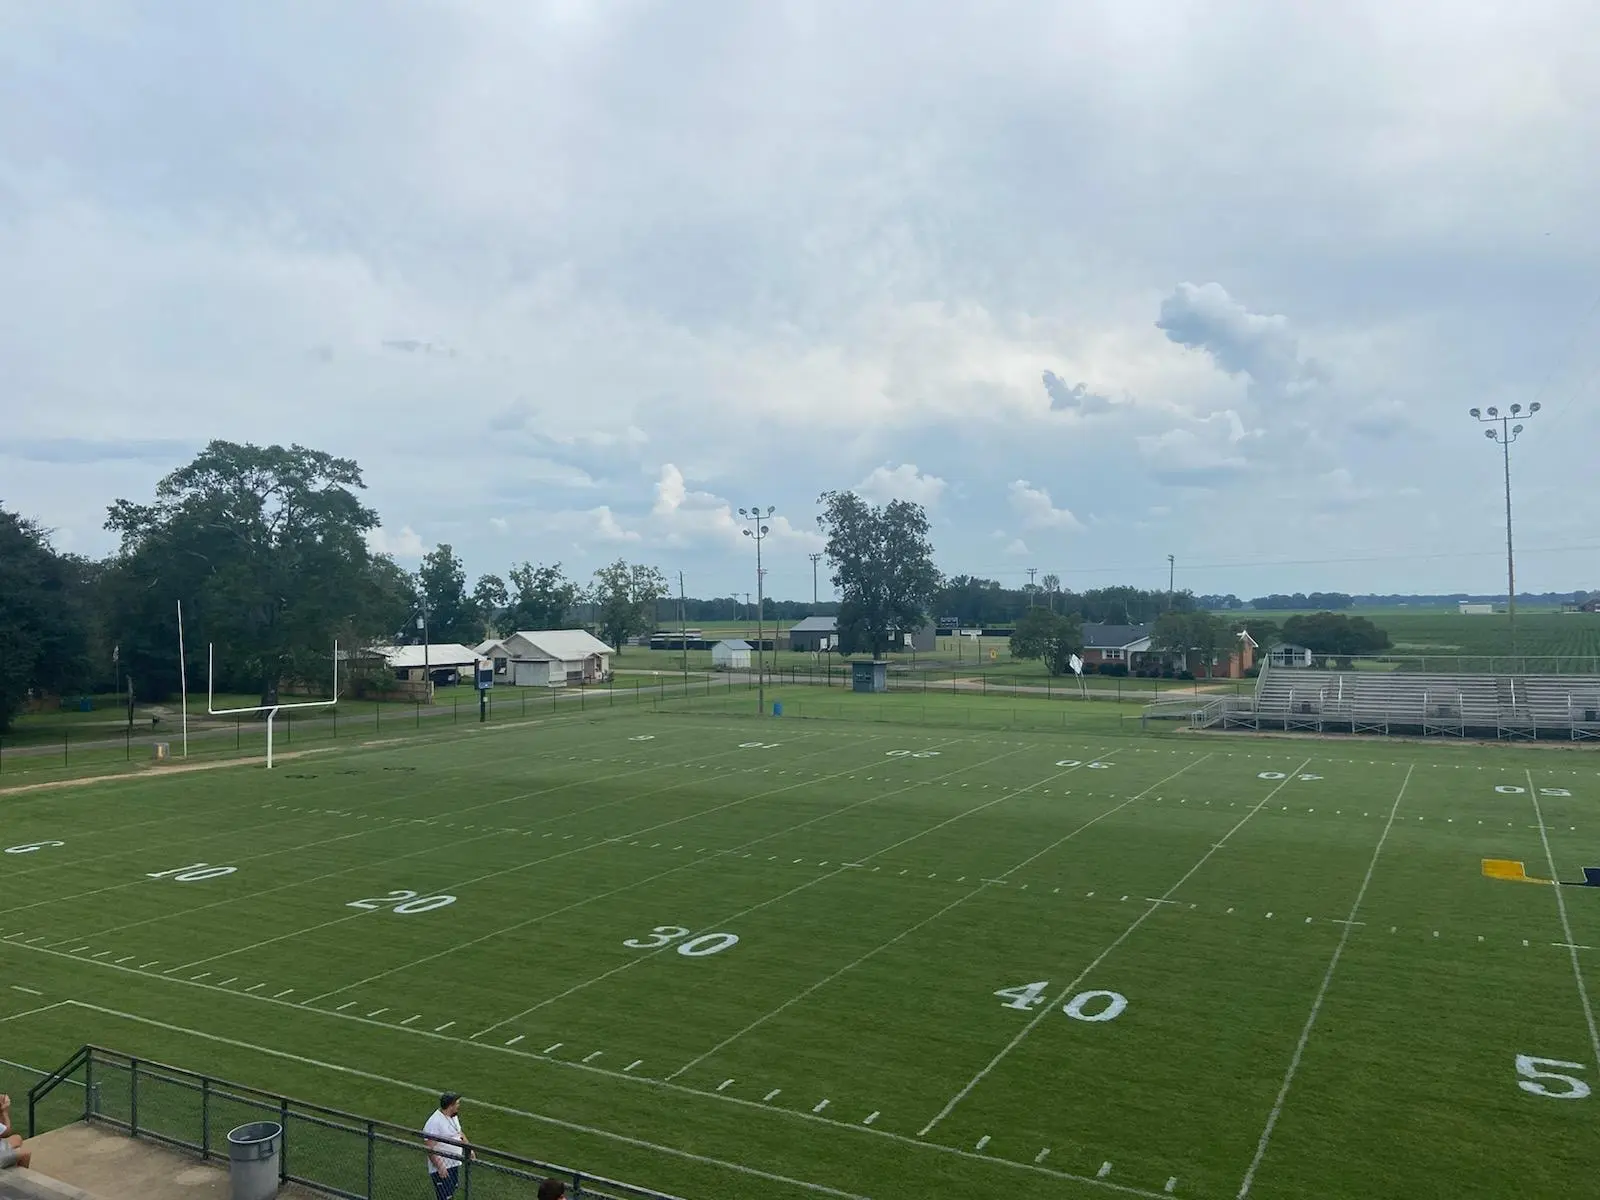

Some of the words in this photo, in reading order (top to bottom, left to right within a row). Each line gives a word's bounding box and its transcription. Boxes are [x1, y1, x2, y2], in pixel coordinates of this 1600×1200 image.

[1494, 785, 1572, 797] 50
[146, 862, 238, 882] 10
[346, 890, 457, 914] 20
[623, 925, 740, 957] 30
[993, 980, 1129, 1022] 40
